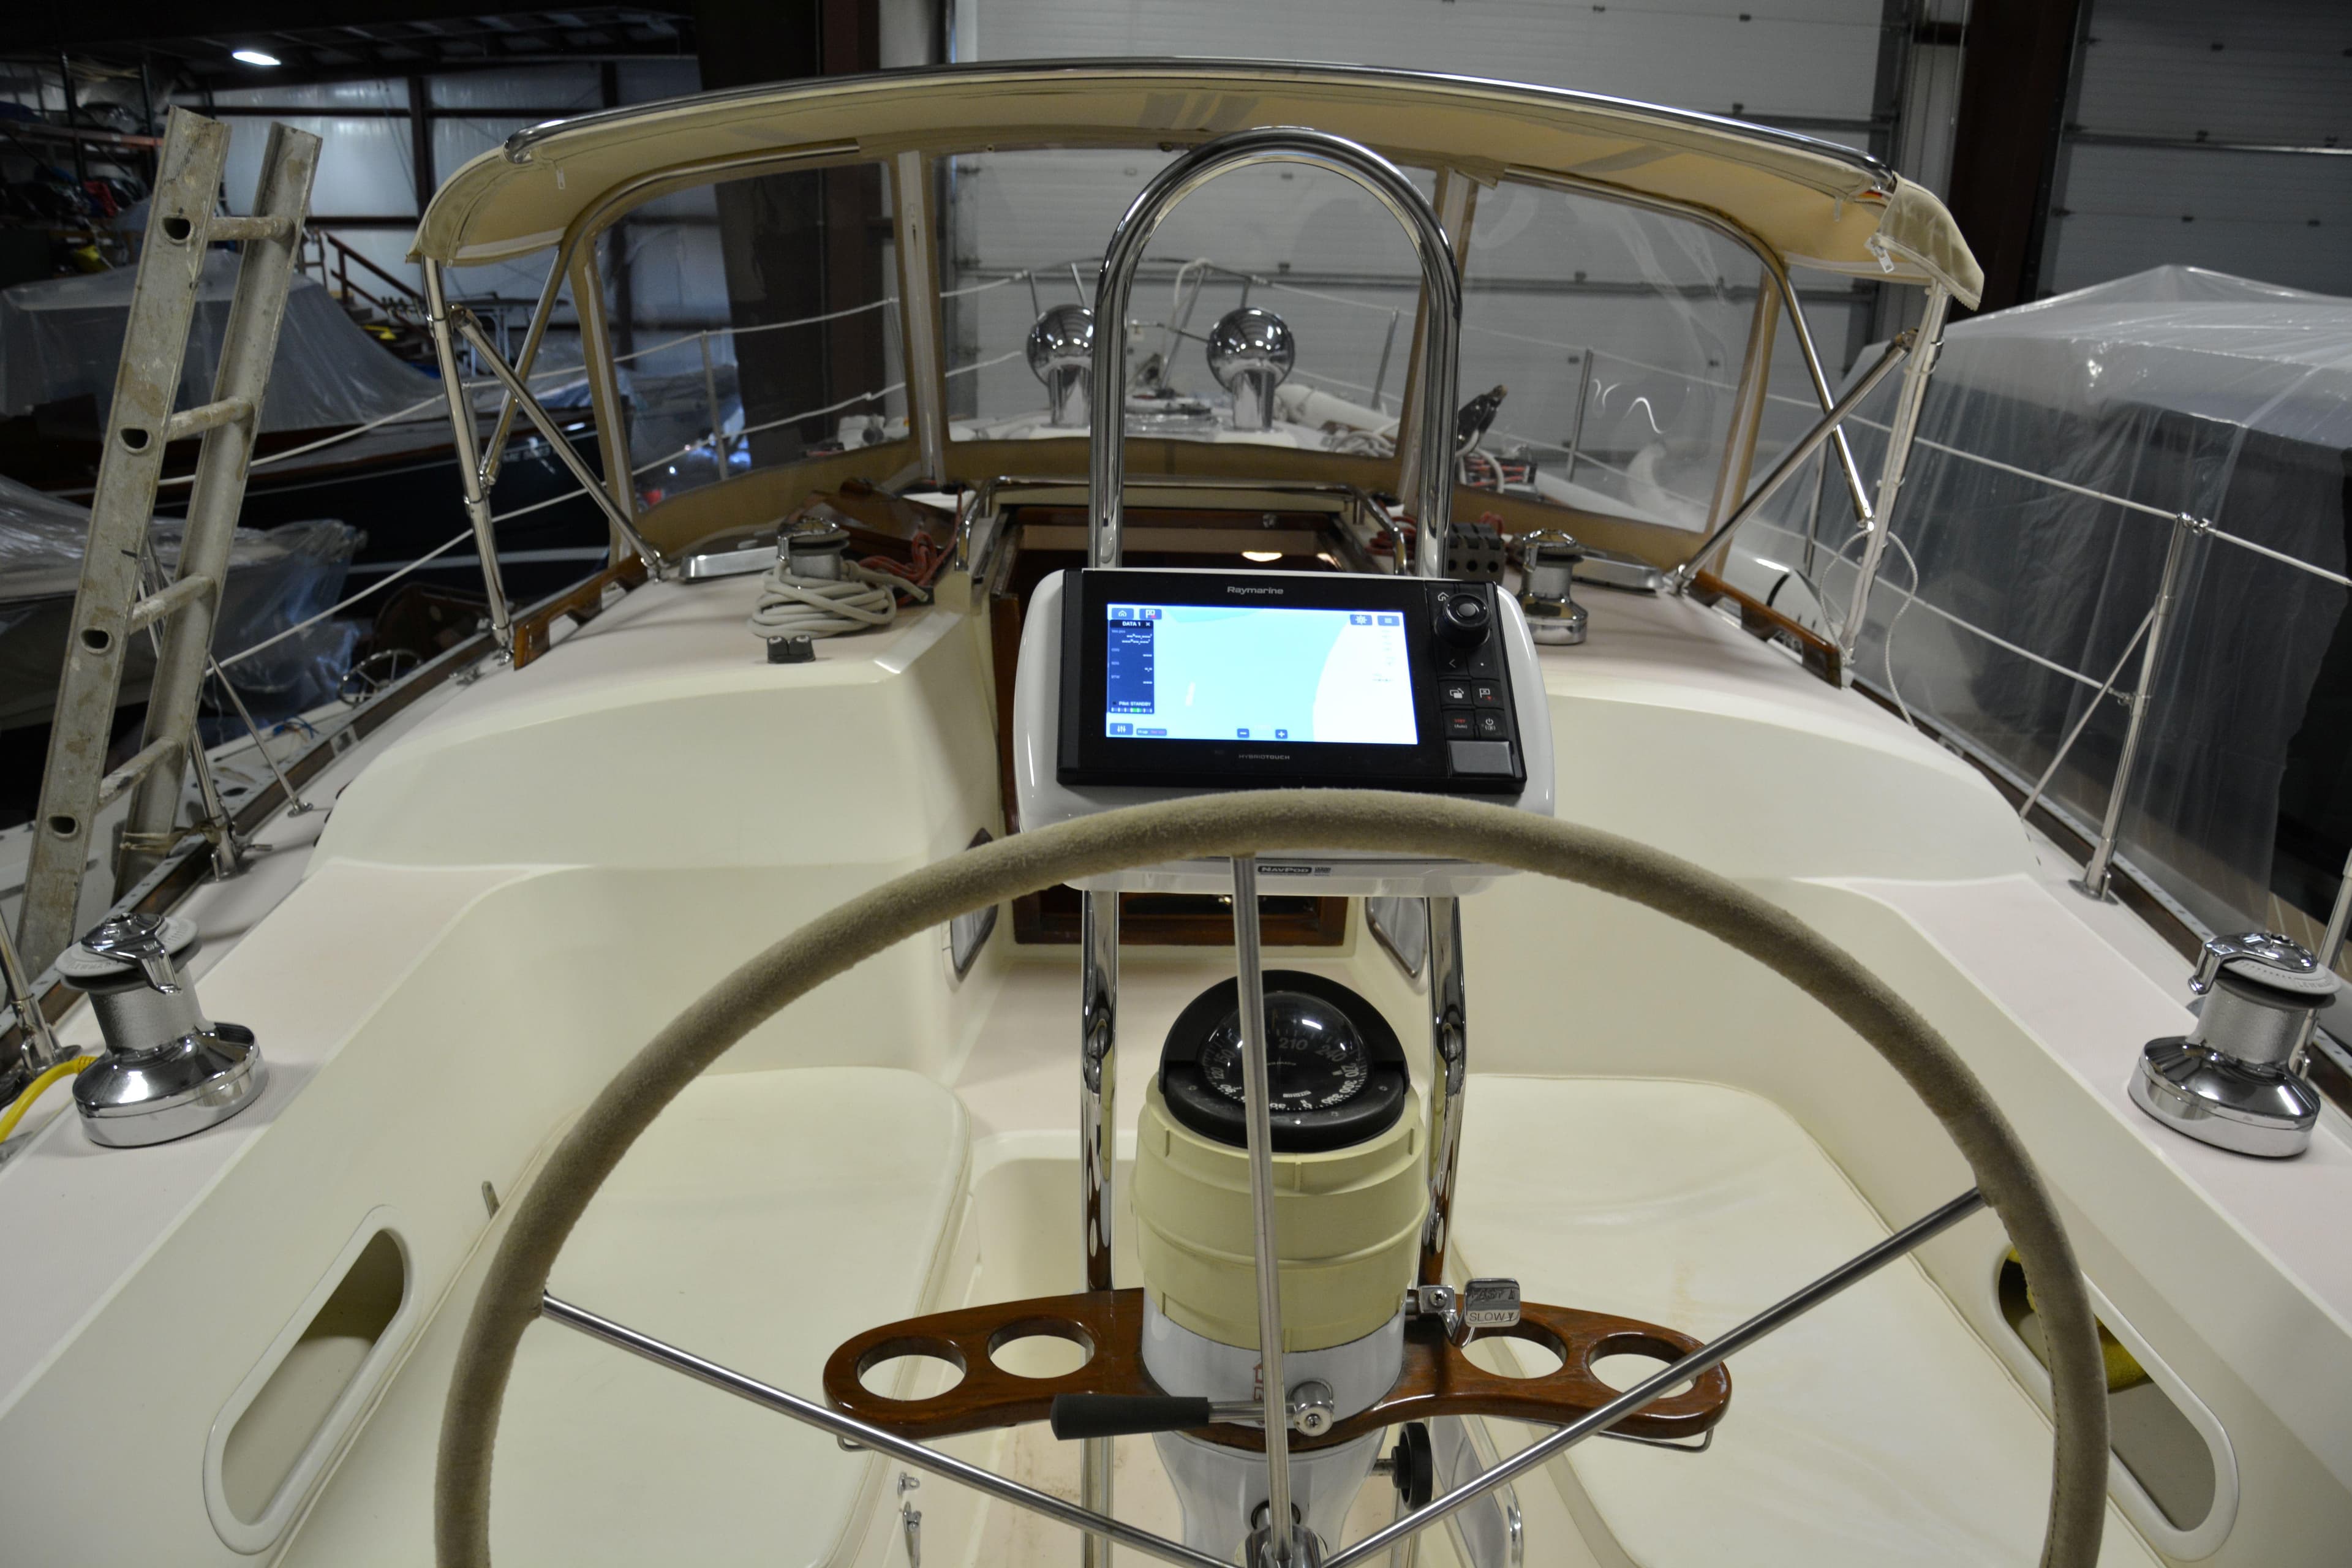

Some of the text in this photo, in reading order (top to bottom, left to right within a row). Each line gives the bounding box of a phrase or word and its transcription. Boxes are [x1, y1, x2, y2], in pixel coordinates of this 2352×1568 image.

[1227, 586, 1284, 595] Raymarine
[1278, 1038, 1308, 1050] 210
[1315, 1044, 1348, 1062] 240
[1341, 1063, 1359, 1077] 270
[1339, 1080, 1357, 1093] 300
[1469, 1312, 1505, 1322] SLOW
